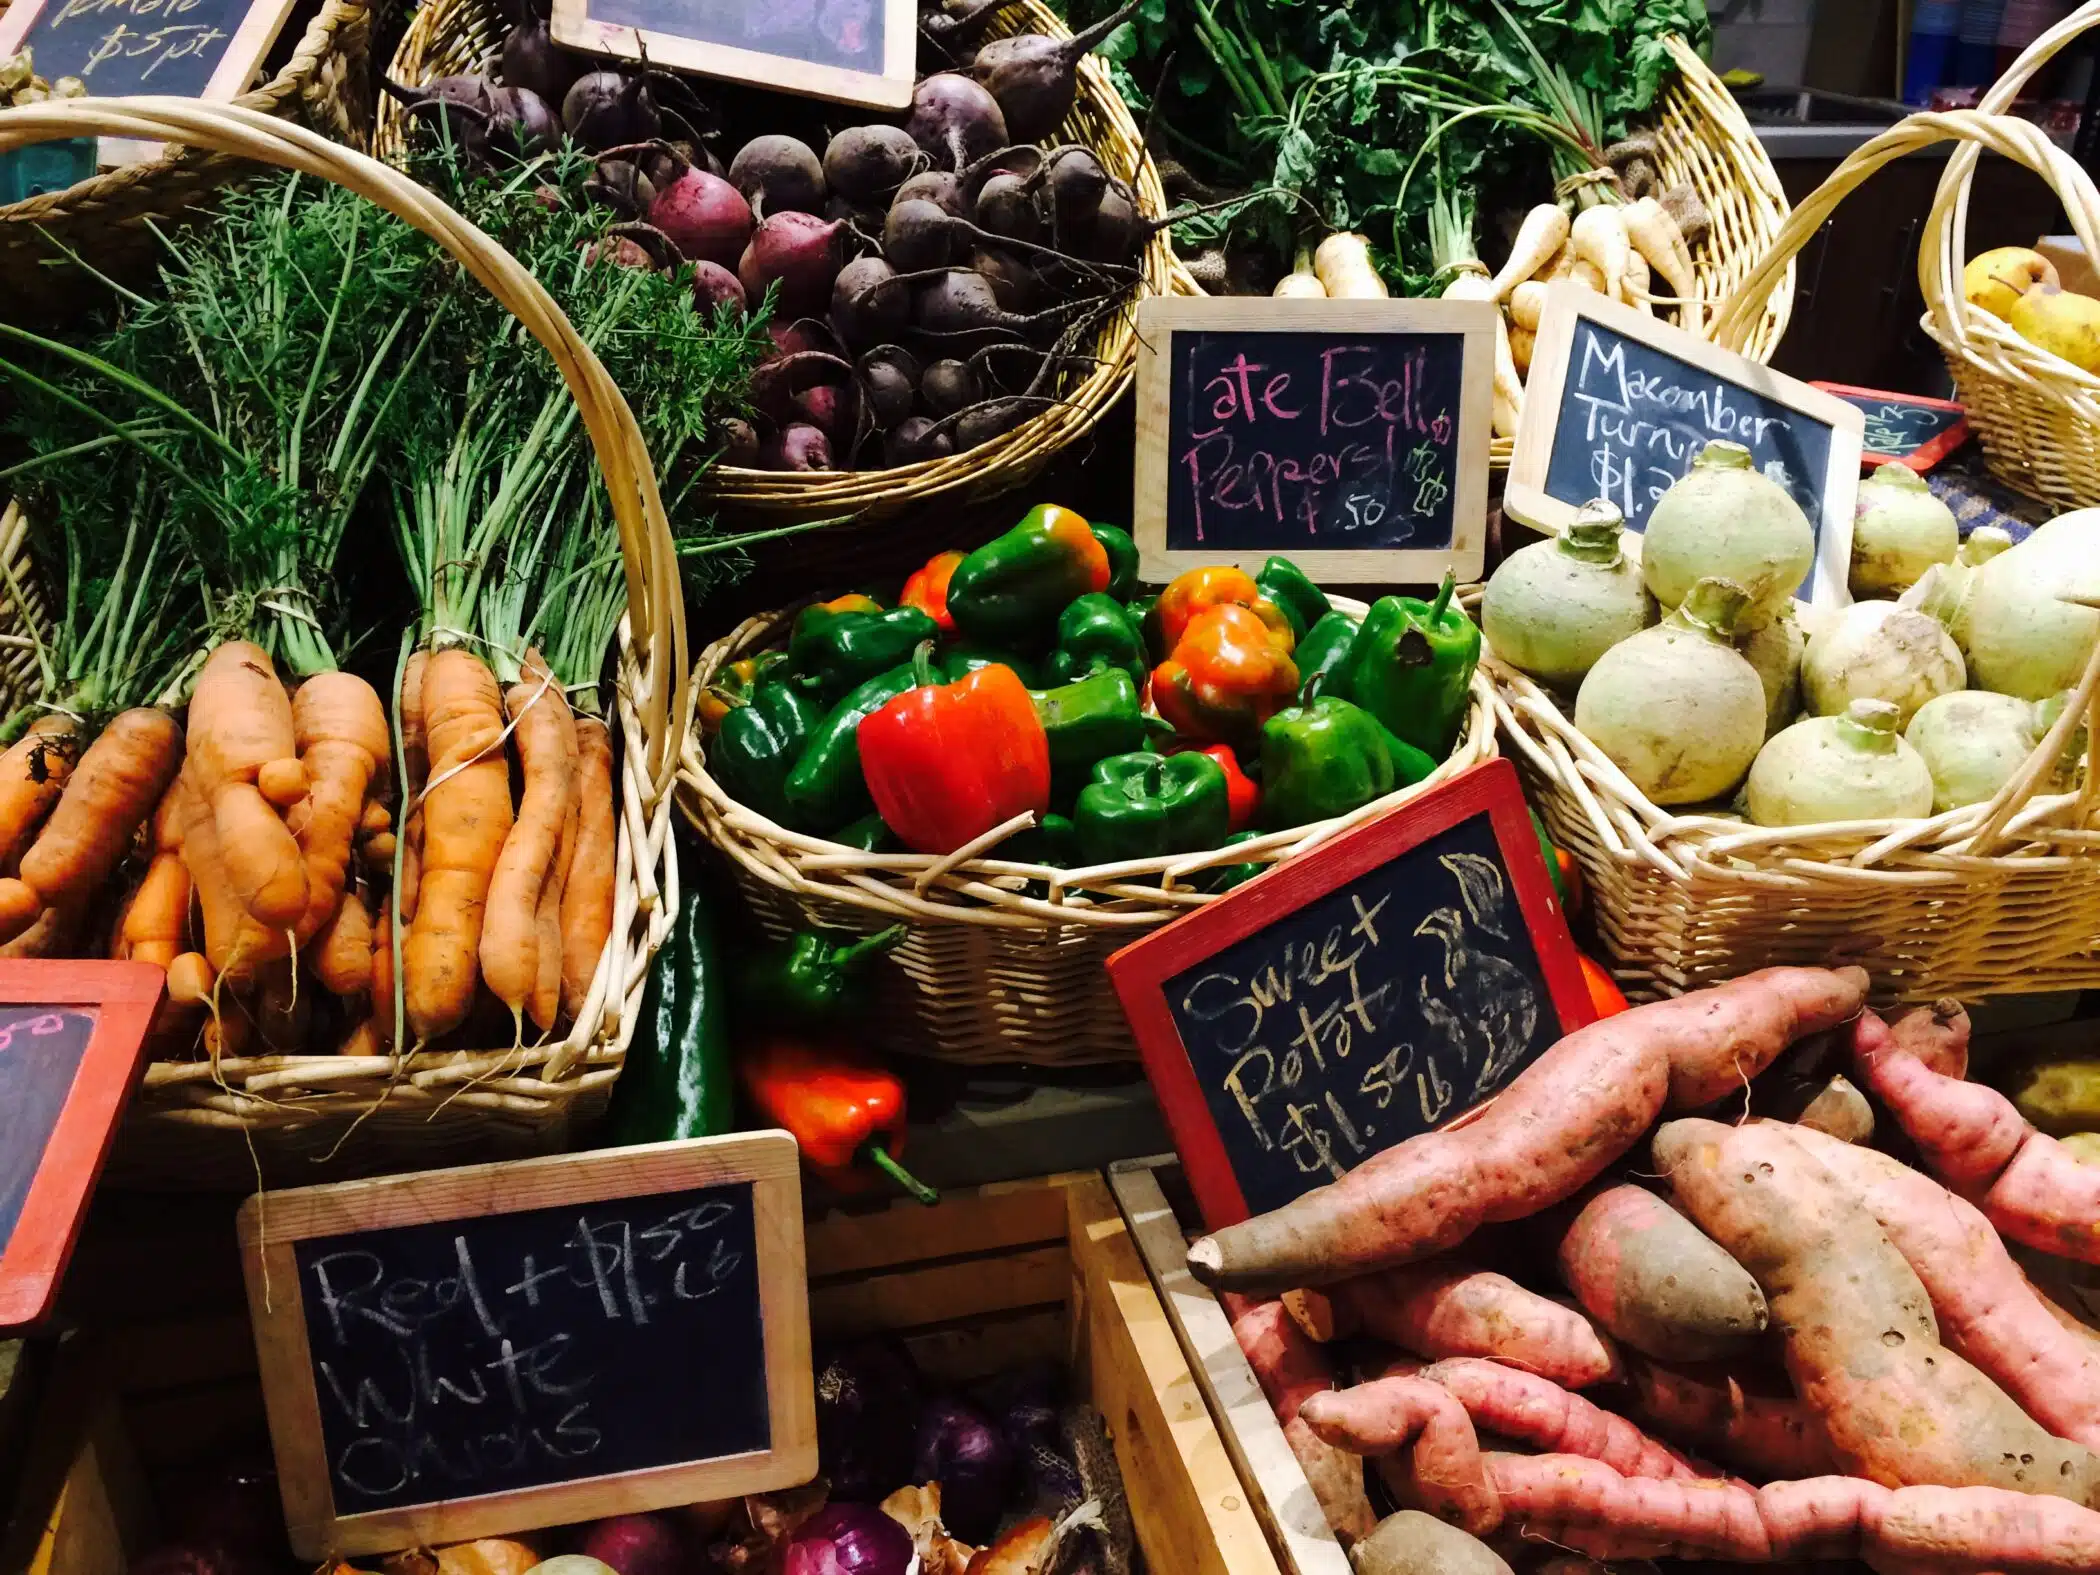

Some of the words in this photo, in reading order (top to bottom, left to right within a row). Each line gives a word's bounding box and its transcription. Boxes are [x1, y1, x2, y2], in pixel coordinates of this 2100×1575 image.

[1187, 346, 1307, 439] Late
[1183, 891, 1392, 1056] Sweet
[311, 1235, 501, 1345] Red
[505, 1254, 568, 1305] +
